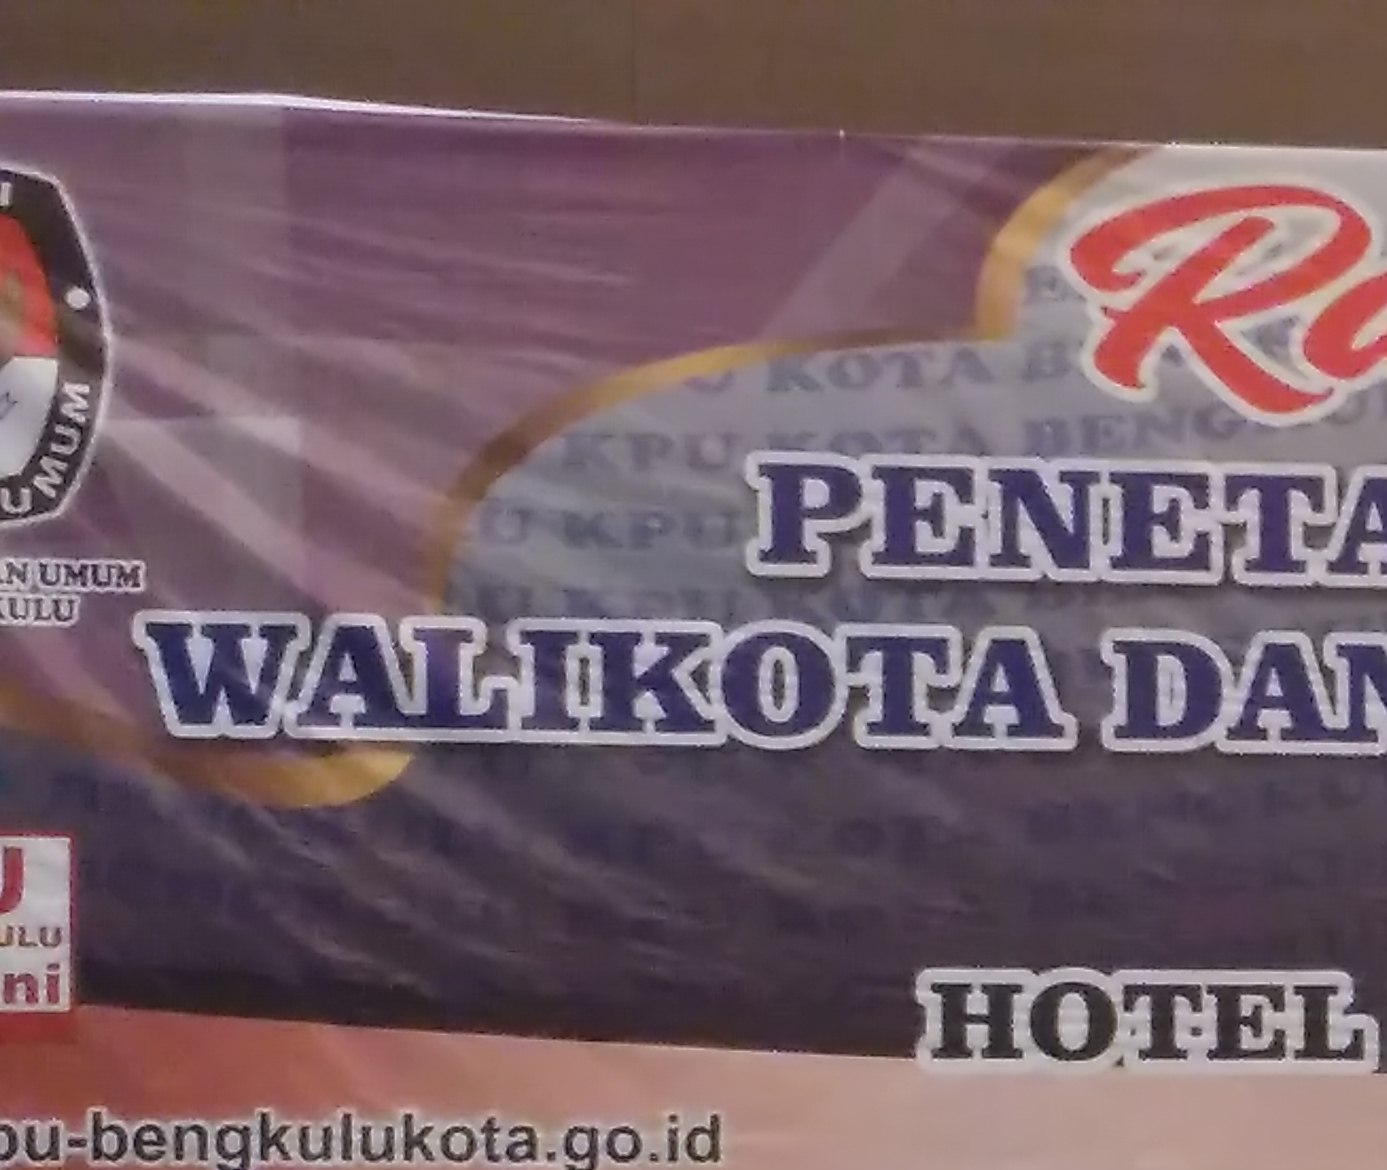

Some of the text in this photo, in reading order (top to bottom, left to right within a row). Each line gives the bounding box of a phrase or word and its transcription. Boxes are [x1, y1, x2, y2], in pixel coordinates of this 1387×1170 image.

[39, 563, 141, 588] UMUM
[143, 622, 1066, 740] WALIKOTA
[928, 980, 1366, 1064] HOTEL
